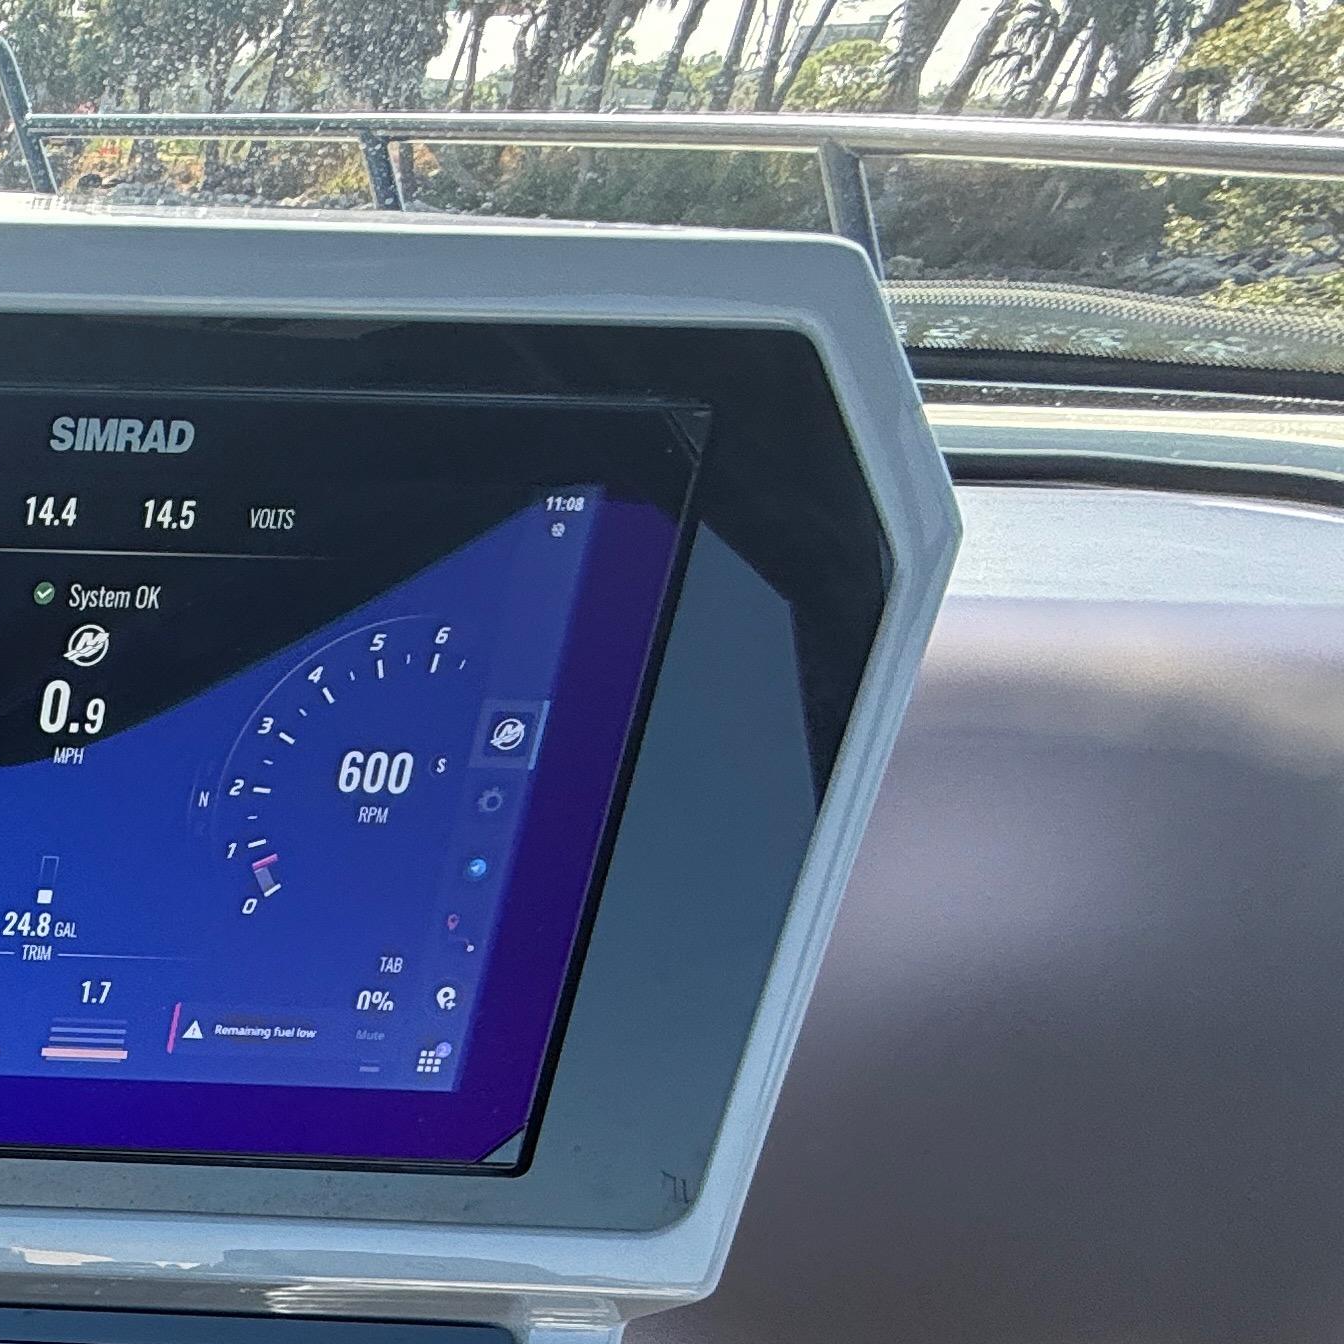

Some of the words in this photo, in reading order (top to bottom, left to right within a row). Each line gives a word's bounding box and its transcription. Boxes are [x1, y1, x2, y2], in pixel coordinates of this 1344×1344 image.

[50, 416, 195, 454] SIMRAD
[546, 496, 585, 512] 11:08
[25, 497, 77, 528] 14.4
[143, 499, 197, 530] 14.5
[249, 508, 295, 530] VOLTS
[69, 584, 130, 612] System
[135, 586, 161, 609] OK
[370, 634, 386, 651] 5
[435, 627, 450, 644] 6
[308, 665, 323, 682] 4
[39, 680, 105, 735] 0.9
[258, 718, 273, 734] 3
[53, 748, 84, 764] MPH
[338, 751, 413, 795] 600
[230, 780, 244, 796] 2
[198, 791, 210, 808] N
[358, 807, 389, 824] RPM
[227, 842, 238, 858] 1
[243, 898, 257, 914] 0
[2, 912, 51, 937] 24.8
[54, 921, 77, 938] GAL
[22, 944, 53, 961] TRIM
[379, 956, 403, 973] TAB
[81, 981, 111, 1005] 1.7
[214, 1024, 271, 1040] Remaining
[273, 1025, 294, 1039] fuel
[296, 1026, 317, 1039] low
